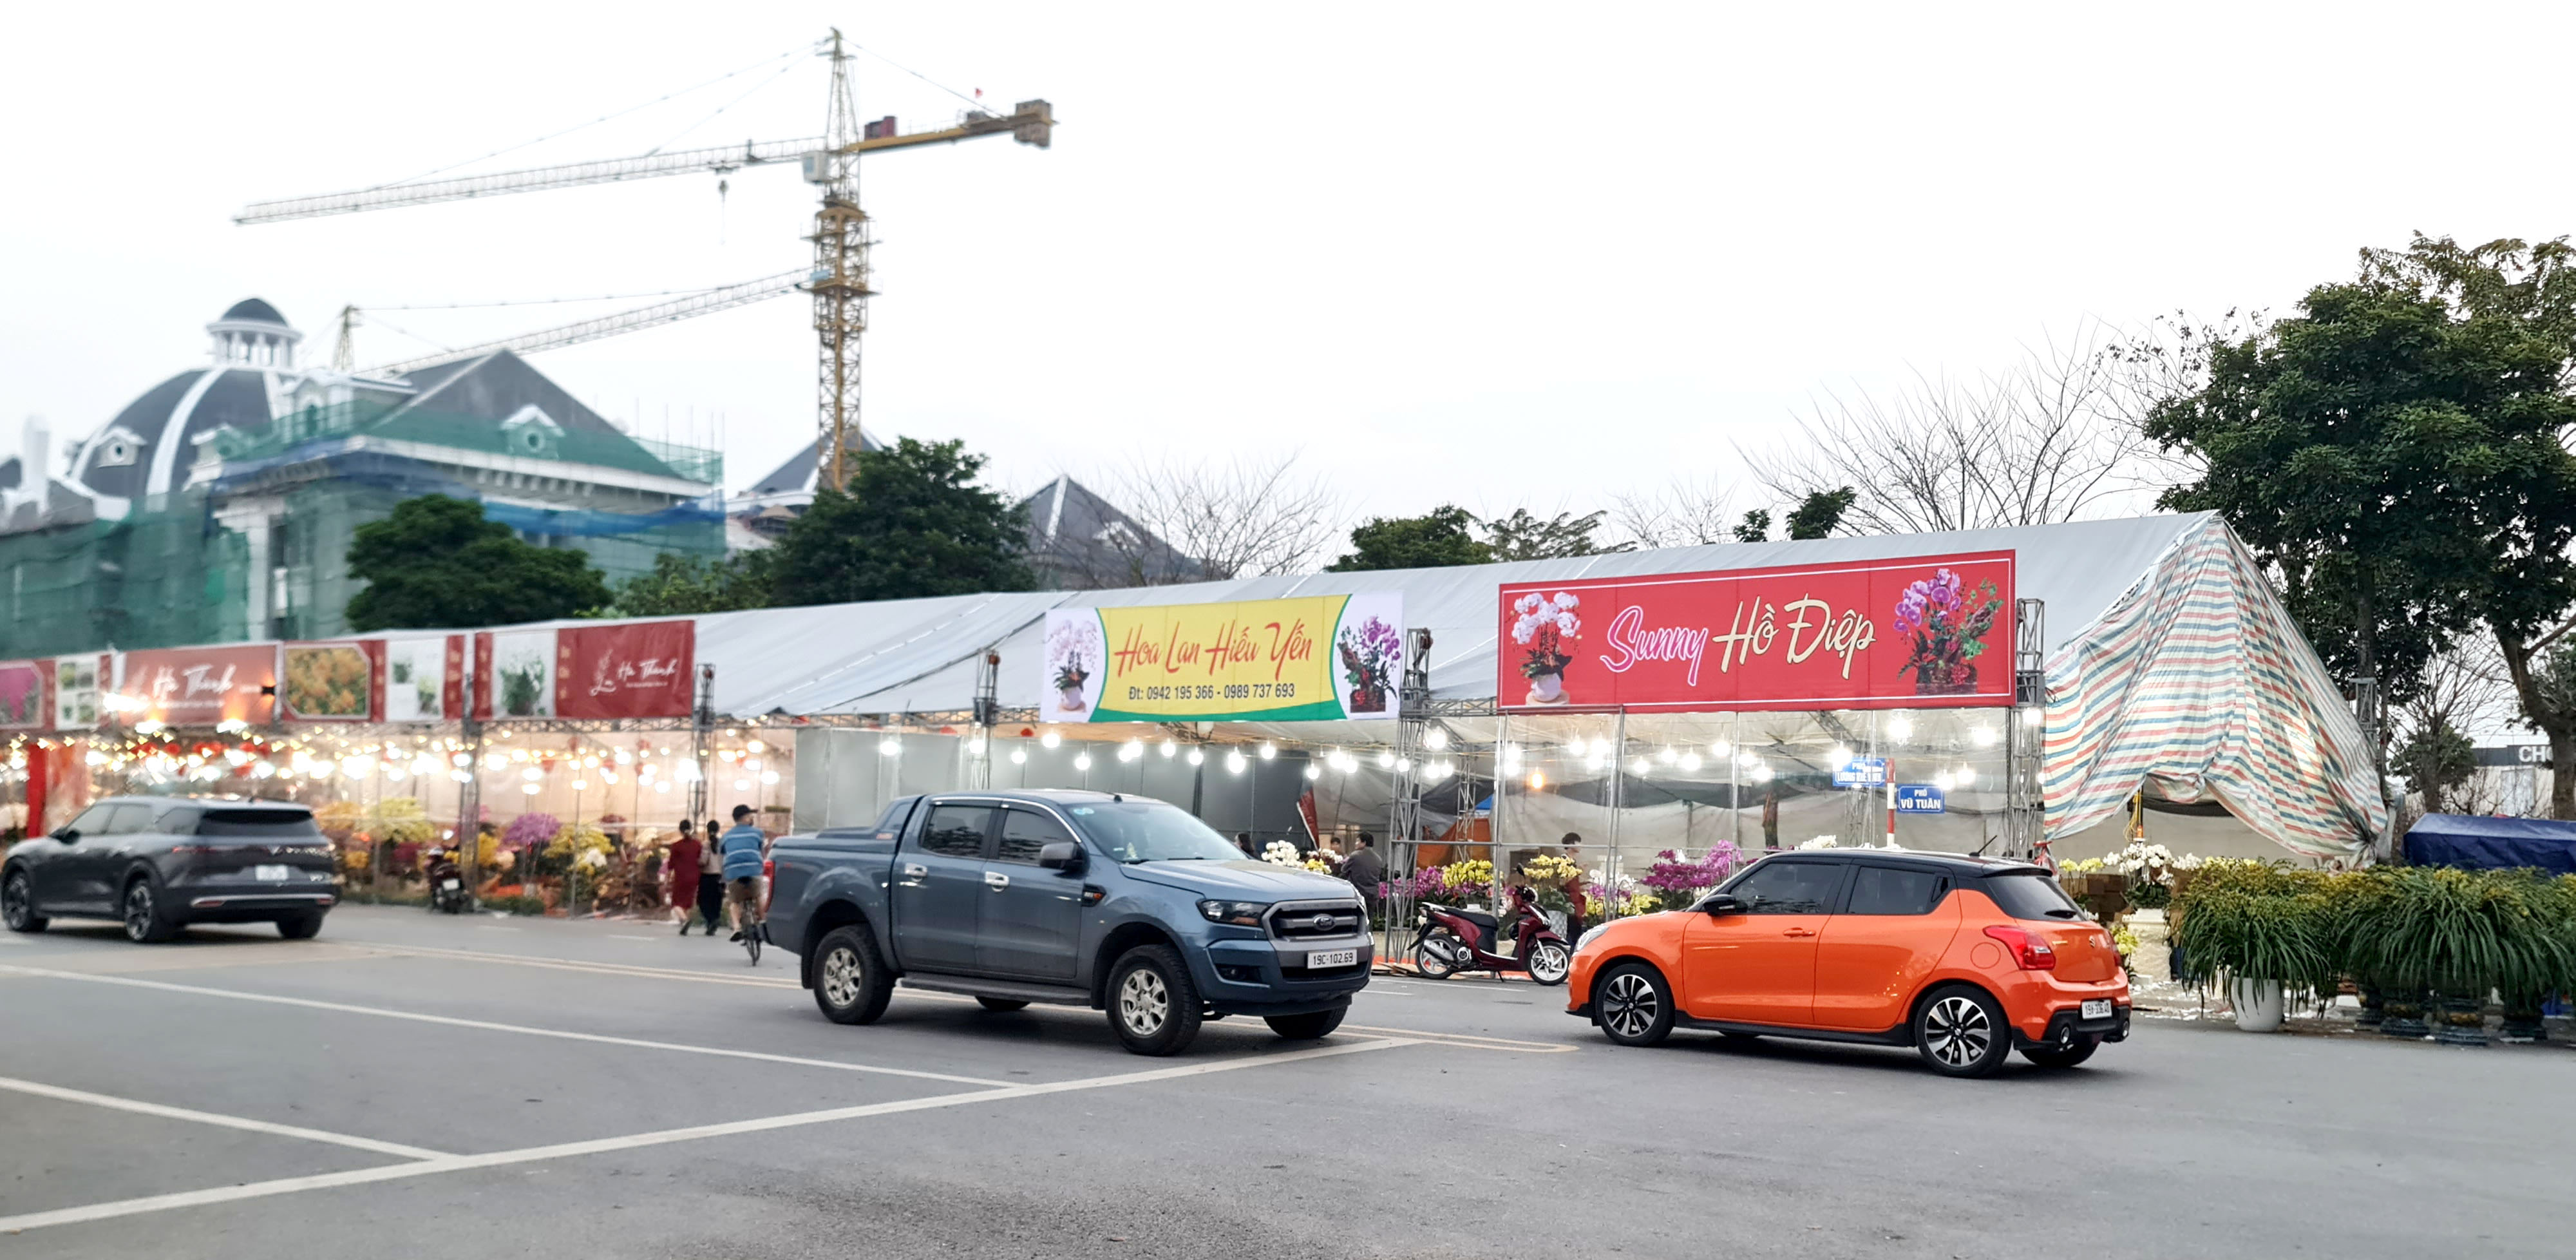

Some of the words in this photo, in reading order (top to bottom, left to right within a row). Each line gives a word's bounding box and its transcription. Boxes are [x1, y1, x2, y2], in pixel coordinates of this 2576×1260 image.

[1114, 623, 1161, 678] Hoa
[1166, 621, 1200, 674] Lan
[1205, 620, 1260, 676] Hiếu
[1265, 618, 1312, 682] Yến
[1599, 605, 1709, 687] Sunny
[1712, 595, 1779, 674] Hồ
[1783, 593, 1876, 680] Điệp
[1129, 686, 1143, 700] Đt:
[1147, 686, 1170, 700] 0942
[1175, 685, 1191, 700] 195
[1195, 685, 1213, 699] 366
[1224, 684, 1249, 698] 0989
[1253, 683, 1271, 698] 737
[1275, 683, 1294, 698] 693
[1314, 953, 1353, 966] 19C-102.69
